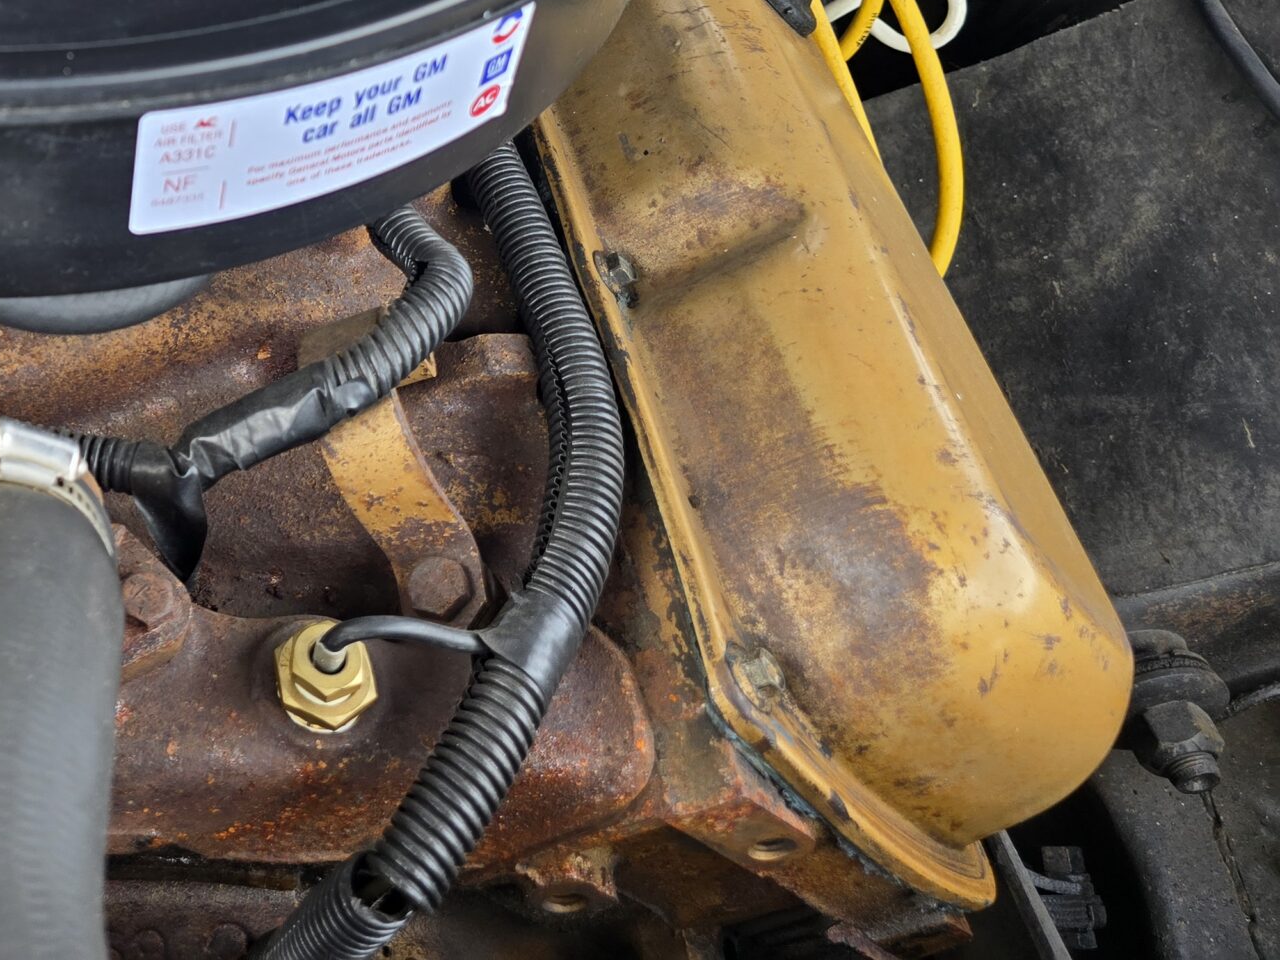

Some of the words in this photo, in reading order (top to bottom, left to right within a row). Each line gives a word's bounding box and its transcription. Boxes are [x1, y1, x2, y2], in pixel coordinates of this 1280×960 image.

[486, 52, 509, 77] GM
[284, 96, 342, 126] Keep
[353, 75, 403, 110] your
[412, 53, 448, 83] GM
[471, 89, 497, 113] AC
[302, 121, 339, 144] car
[349, 103, 377, 129] all
[386, 86, 423, 116] GM
[153, 137, 177, 149] AIR
[179, 129, 224, 145] FILTER
[160, 121, 187, 134] USE
[160, 144, 216, 164] A331C
[246, 171, 286, 186] specify
[288, 157, 330, 176] General
[330, 147, 366, 162] Motors
[367, 135, 393, 150] parts
[396, 115, 440, 138] identified
[269, 149, 322, 170] maximum
[323, 127, 388, 155] performance
[324, 161, 353, 176] these
[163, 173, 198, 194] NF
